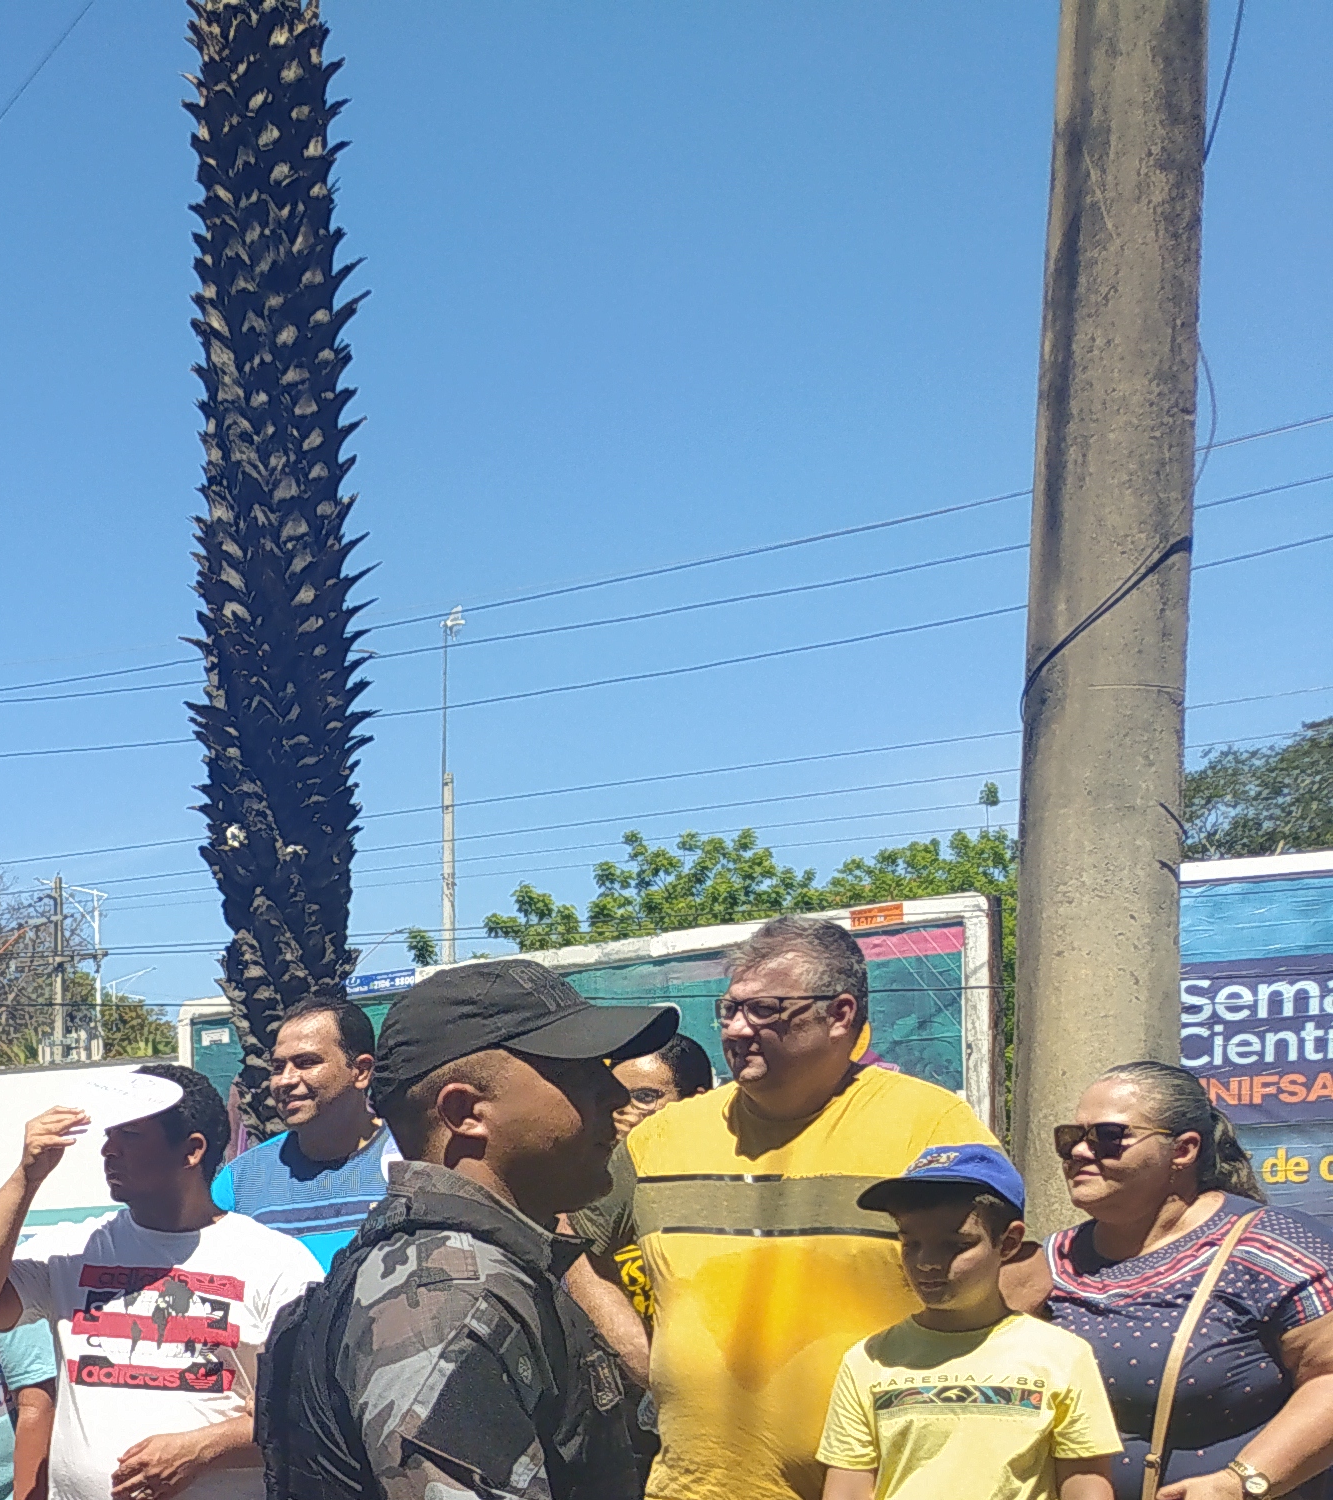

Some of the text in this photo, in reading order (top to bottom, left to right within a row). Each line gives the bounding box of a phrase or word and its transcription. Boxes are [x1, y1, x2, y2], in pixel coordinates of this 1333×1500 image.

[1199, 1071, 1333, 1106] NIFSA
[1262, 1146, 1309, 1183] de
[82, 1365, 181, 1388] adidas
